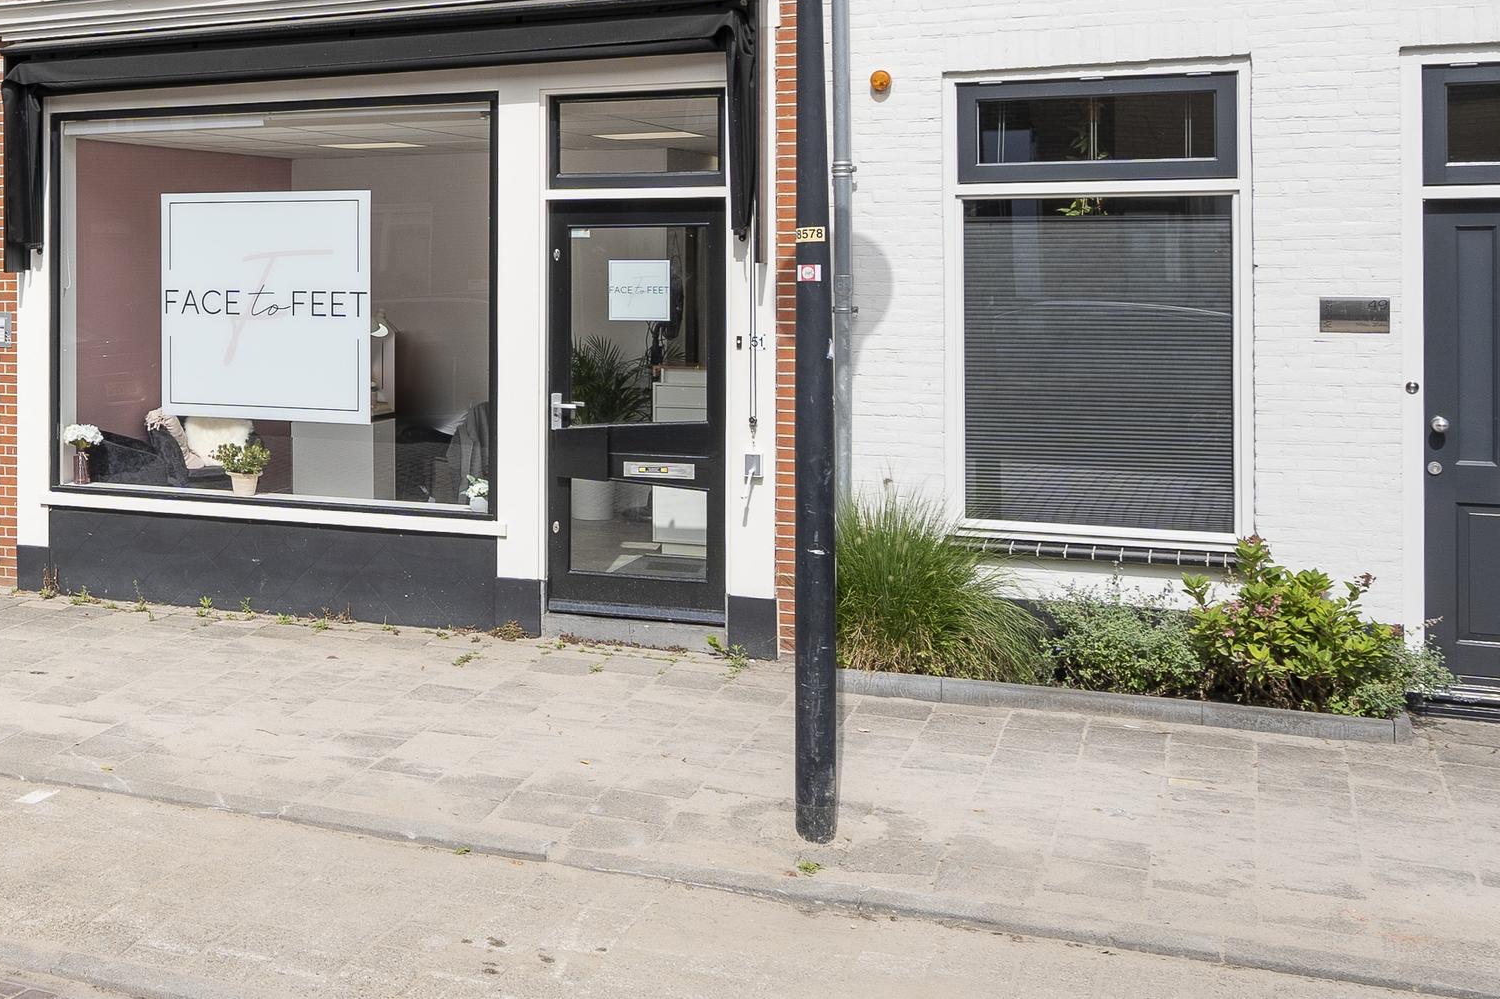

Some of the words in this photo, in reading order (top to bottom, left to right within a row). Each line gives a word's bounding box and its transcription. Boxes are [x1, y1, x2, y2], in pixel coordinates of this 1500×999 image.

[608, 286, 633, 294] FACE
[646, 286, 669, 294] FEET
[165, 290, 240, 315] FACE
[248, 284, 291, 316] to
[292, 291, 368, 317] FEET
[1368, 299, 1388, 310] 49
[750, 336, 763, 347] 51
